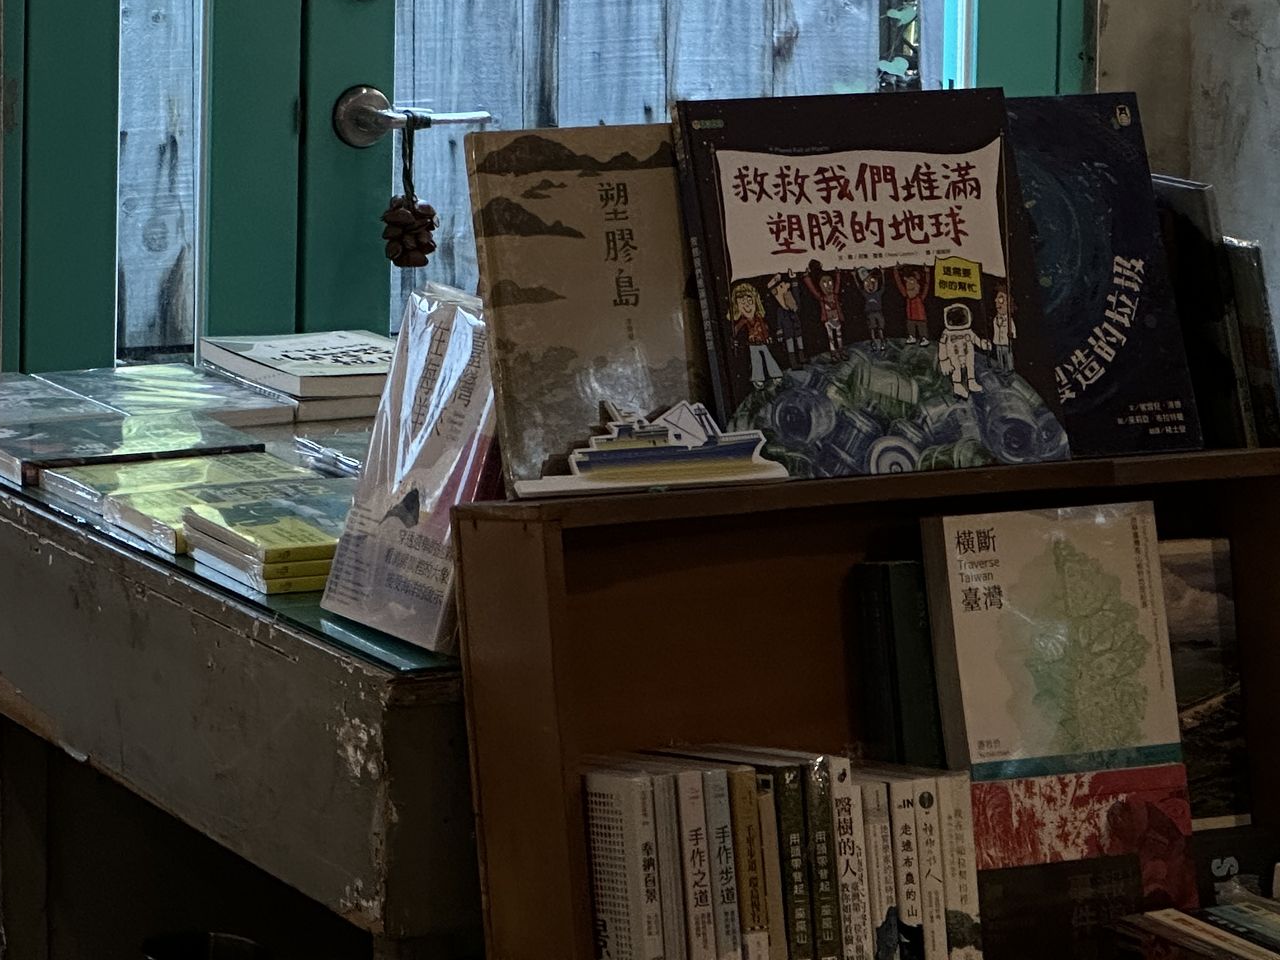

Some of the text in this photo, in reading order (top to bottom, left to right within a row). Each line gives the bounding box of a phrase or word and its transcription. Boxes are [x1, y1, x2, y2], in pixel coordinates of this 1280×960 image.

[732, 161, 982, 204] 救救我們堆滿
[597, 182, 641, 308] 塑膠島
[767, 205, 969, 255] 塑膠的地球
[955, 527, 997, 555] 橫斷
[957, 556, 1000, 570] Traverse
[959, 570, 994, 584] Taiwan
[961, 585, 1004, 612] 臺灣
[834, 796, 857, 878] 醫樹的人
[687, 827, 711, 908] 手作之道
[714, 824, 736, 905] 手作步道
[900, 823, 918, 918] 走進布農的山
